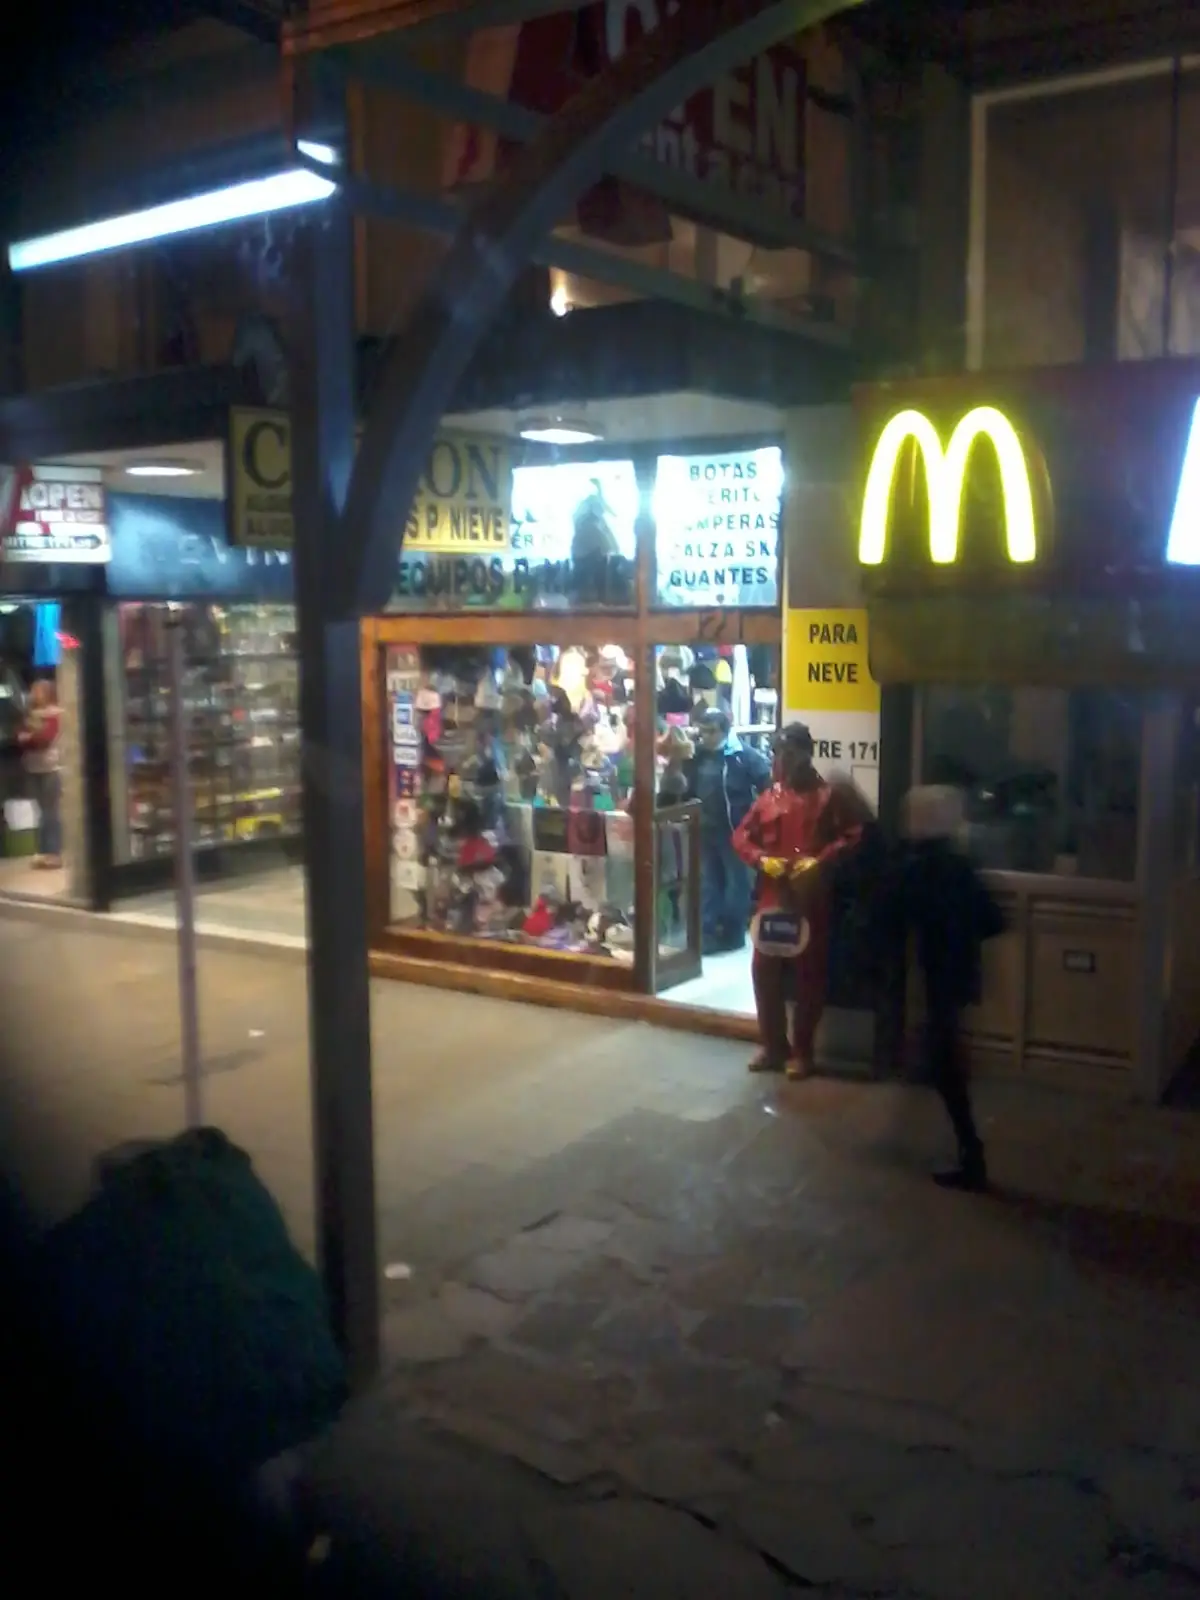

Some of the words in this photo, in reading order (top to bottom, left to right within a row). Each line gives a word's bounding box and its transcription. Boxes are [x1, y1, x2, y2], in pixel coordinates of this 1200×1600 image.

[689, 461, 758, 482] BOTAS
[449, 504, 504, 542] NIEVE
[669, 565, 769, 588] GUANTES
[809, 623, 858, 644] PARA
[807, 662, 859, 683] NEVE
[848, 741, 878, 761] 171
